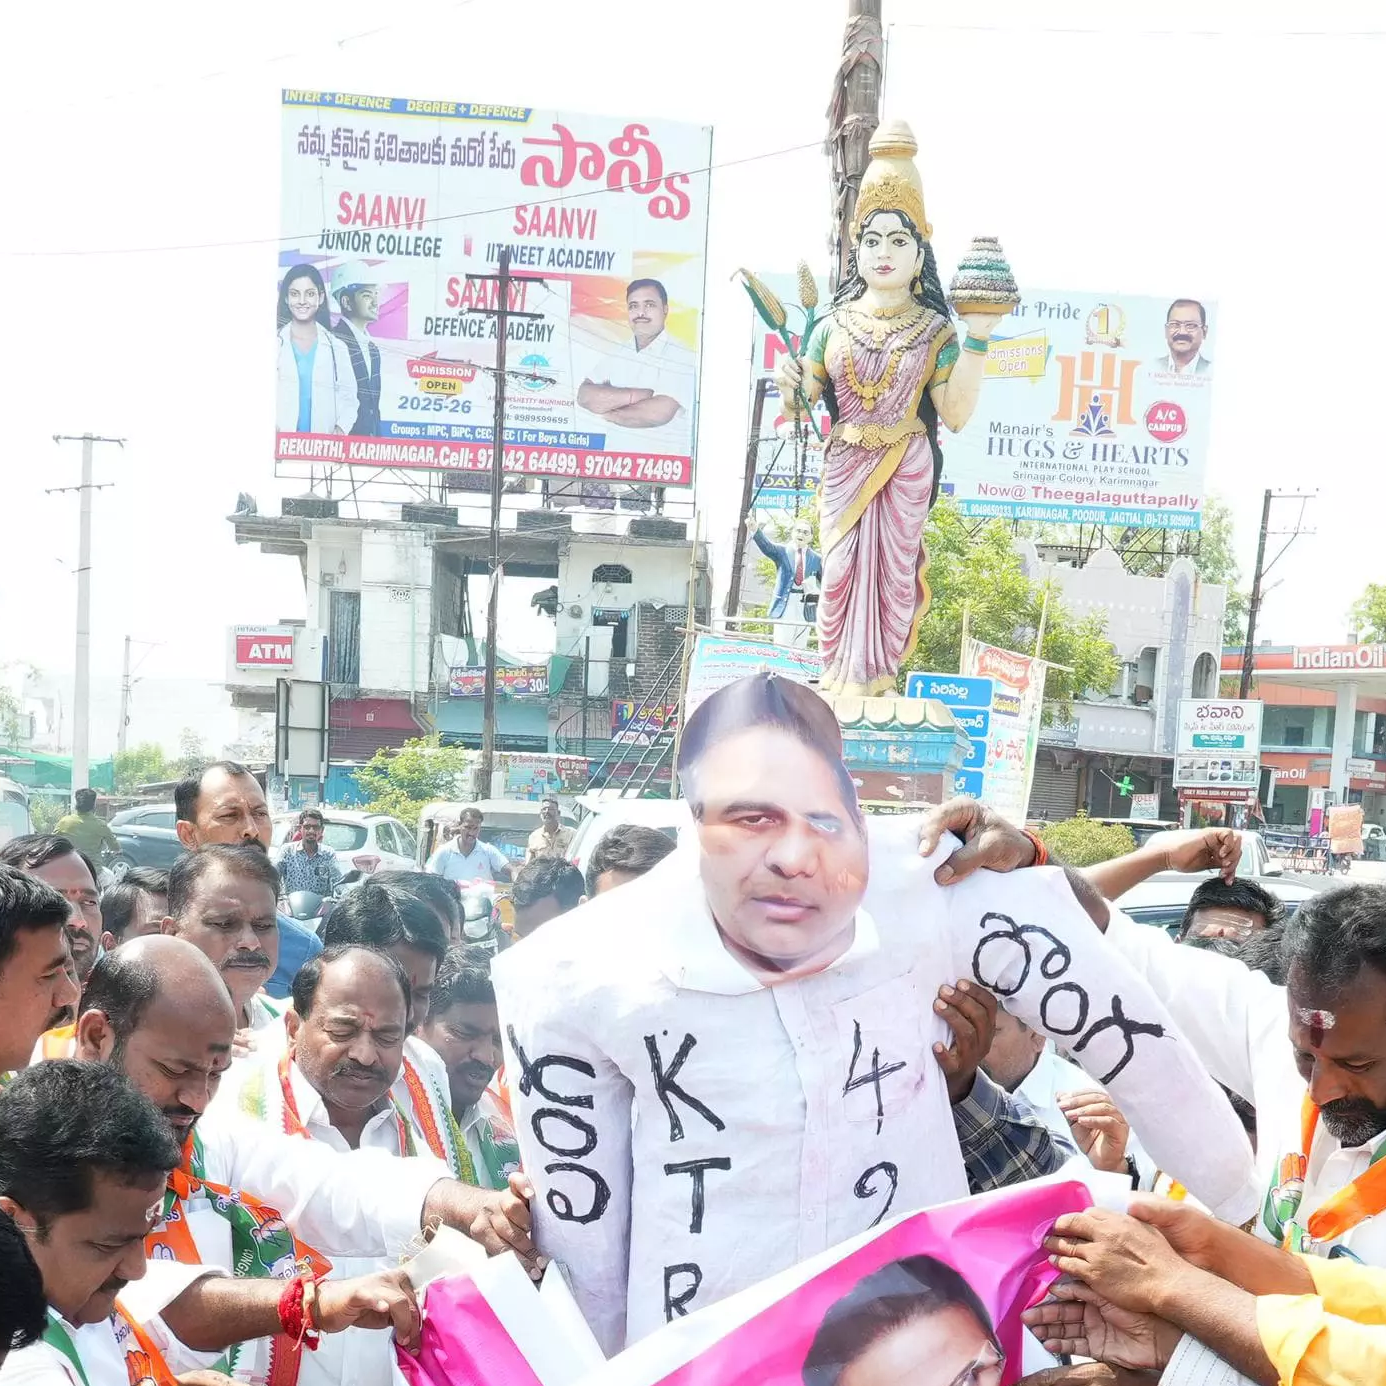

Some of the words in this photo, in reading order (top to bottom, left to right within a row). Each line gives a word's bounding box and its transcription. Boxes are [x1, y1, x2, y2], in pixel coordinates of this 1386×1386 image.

[286, 90, 320, 103] INTER
[335, 93, 392, 109] DEFENCE
[406, 99, 455, 113] DEGREE
[469, 103, 525, 119] DEFENCE
[337, 191, 425, 232] SAANVI
[513, 206, 598, 240] SAANVI
[318, 229, 371, 253] JUNIOR
[376, 233, 442, 259] COLLEGE
[547, 248, 616, 272] ACADEMY
[1035, 301, 1080, 322] Pride
[424, 317, 485, 339] DEFENCE
[489, 321, 555, 343] AADEMY
[411, 365, 472, 378] ADMISSION
[998, 360, 1027, 373] Open
[426, 381, 457, 392] OPEN
[398, 396, 473, 414] 2025-26
[1155, 409, 1176, 421] A/C
[391, 424, 420, 439] Groups
[989, 421, 1054, 438] Manair's
[1148, 422, 1183, 433] CAMPUS
[279, 437, 346, 460] REKURTHI,
[584, 455, 633, 478] 97042
[637, 457, 683, 481] 74499
[987, 437, 1054, 459] HUGS
[1062, 441, 1085, 460] &
[1091, 443, 1190, 467] HEARTS
[1020, 460, 1089, 473] INTERNATIONAL
[1093, 464, 1115, 474] PLAY
[1118, 466, 1151, 476] SCHOOL
[1013, 471, 1056, 484] Srinagar
[1099, 476, 1159, 489] Karimnagar
[978, 482, 1027, 501] Now@
[1031, 486, 1199, 510] Theegalaguttapally
[249, 643, 292, 659] ATM
[1293, 645, 1384, 669] IndianOil
[559, 760, 570, 769] Cell
[1274, 769, 1306, 780] anOil
